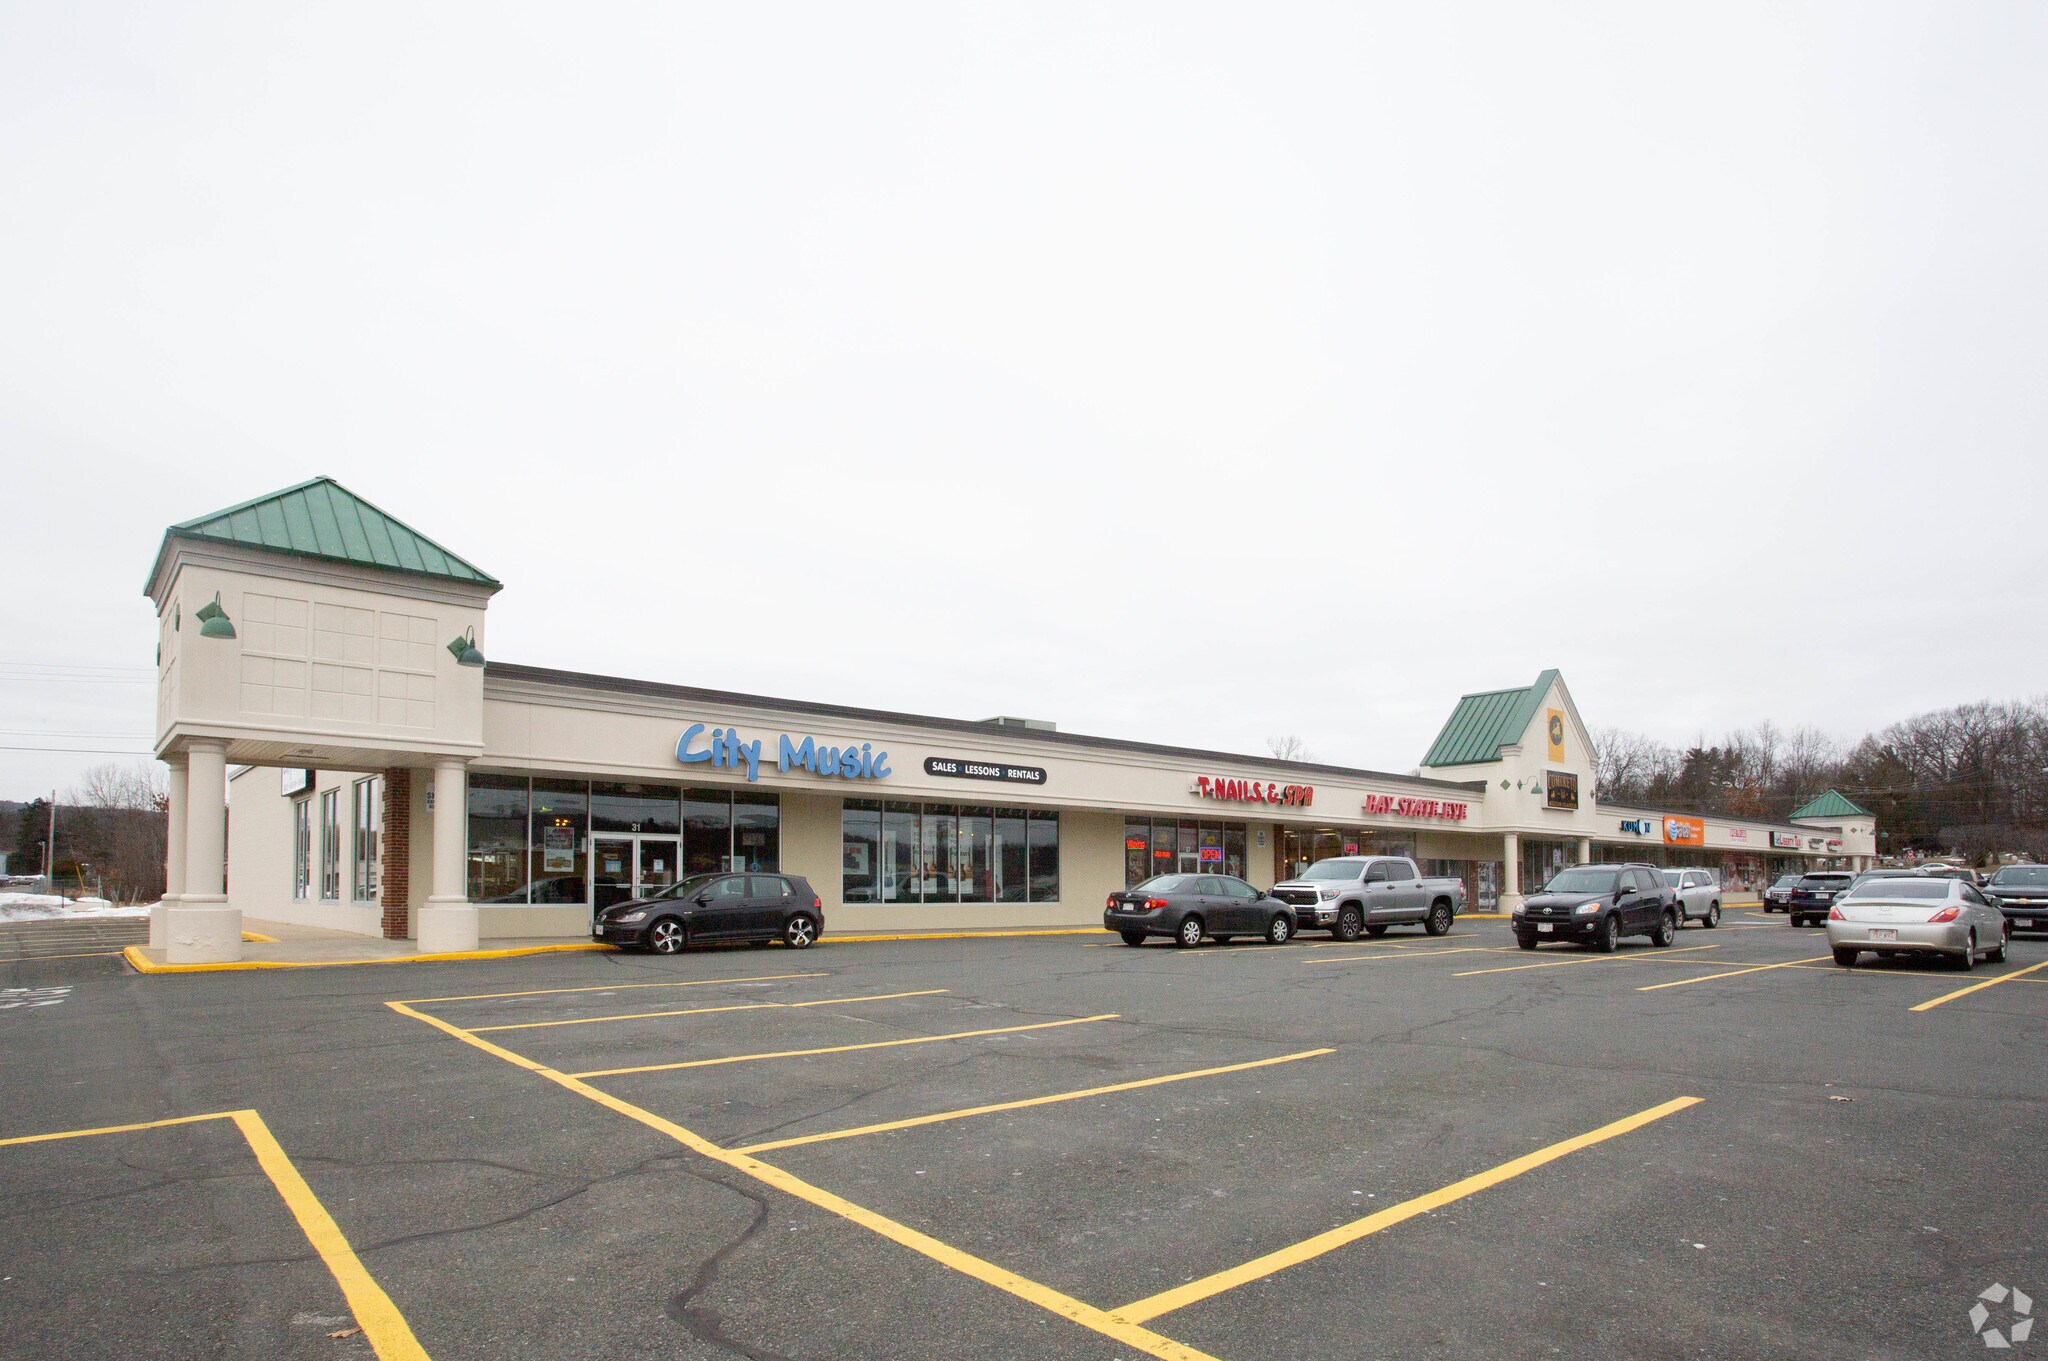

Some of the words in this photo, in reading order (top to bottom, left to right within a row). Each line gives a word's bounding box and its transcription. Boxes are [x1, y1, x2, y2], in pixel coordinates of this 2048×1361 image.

[675, 723, 762, 782] City
[777, 733, 892, 780] Music
[932, 761, 957, 773] SALES
[964, 764, 1000, 777] LESSONS
[1007, 768, 1040, 780] RENTALS
[1265, 783, 1279, 804] &
[1283, 784, 1314, 807] SPA
[1365, 794, 1395, 813] BAY
[1398, 797, 1439, 817] STATE
[1441, 801, 1468, 820] EYE
[1621, 818, 1651, 836] KUMON
[1201, 849, 1221, 861] OPEN
